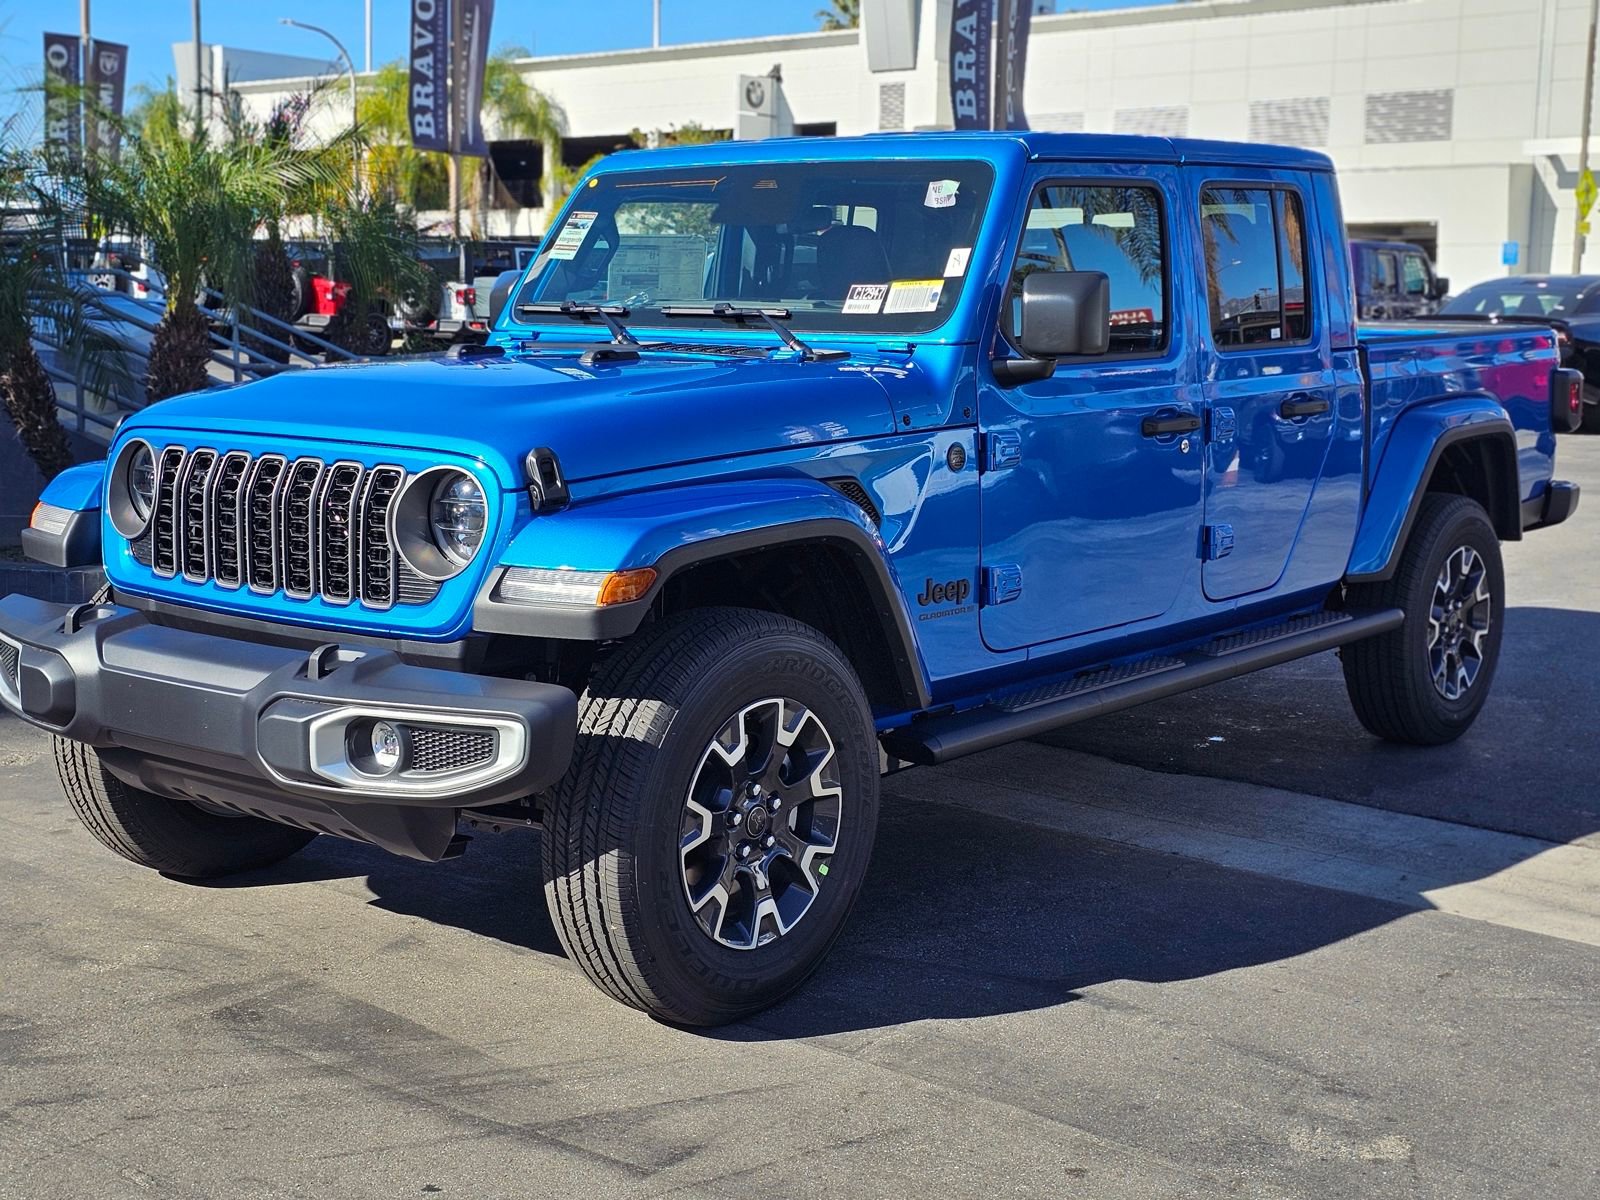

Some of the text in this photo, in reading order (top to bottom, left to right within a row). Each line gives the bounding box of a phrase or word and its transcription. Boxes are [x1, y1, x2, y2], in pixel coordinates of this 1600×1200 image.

[413, 0, 436, 139] BRAVO
[917, 577, 970, 606] Jeep
[918, 606, 966, 621] GLADIATOR
